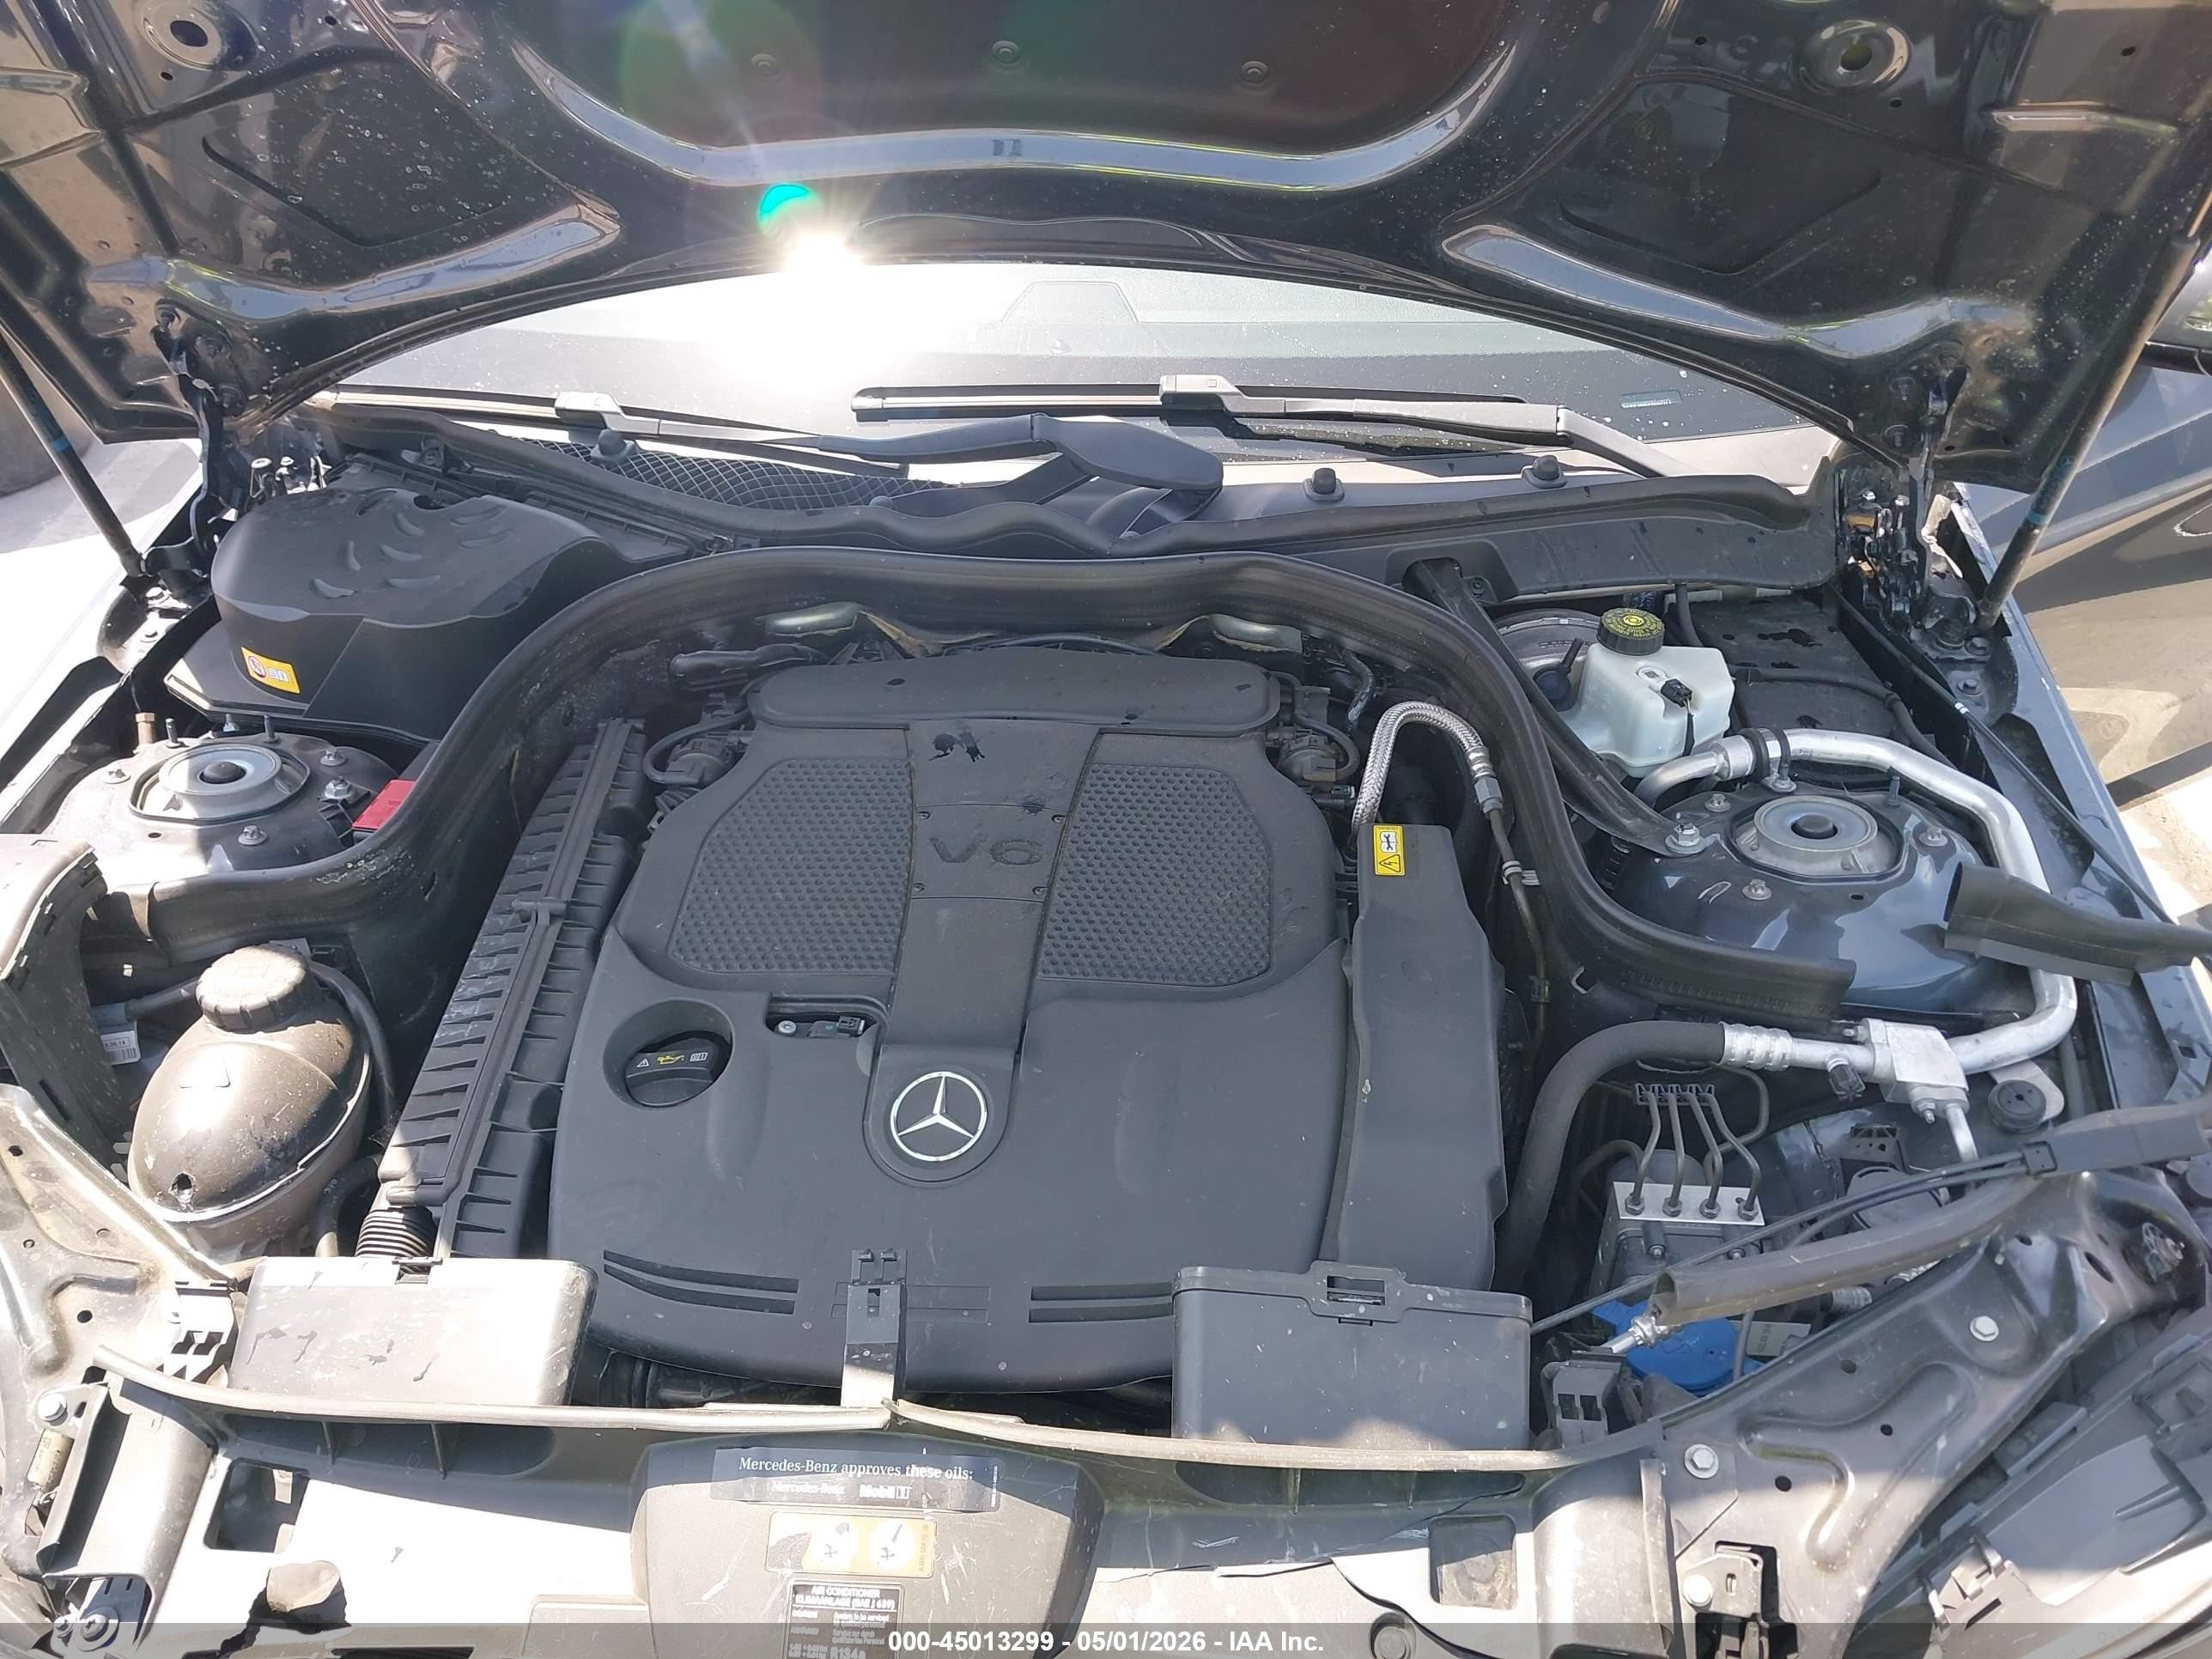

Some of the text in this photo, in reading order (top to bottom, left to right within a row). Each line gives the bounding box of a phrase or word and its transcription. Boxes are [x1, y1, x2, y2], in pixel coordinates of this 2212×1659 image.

[738, 1457, 974, 1480] Mercedes-Benz approves these oils:
